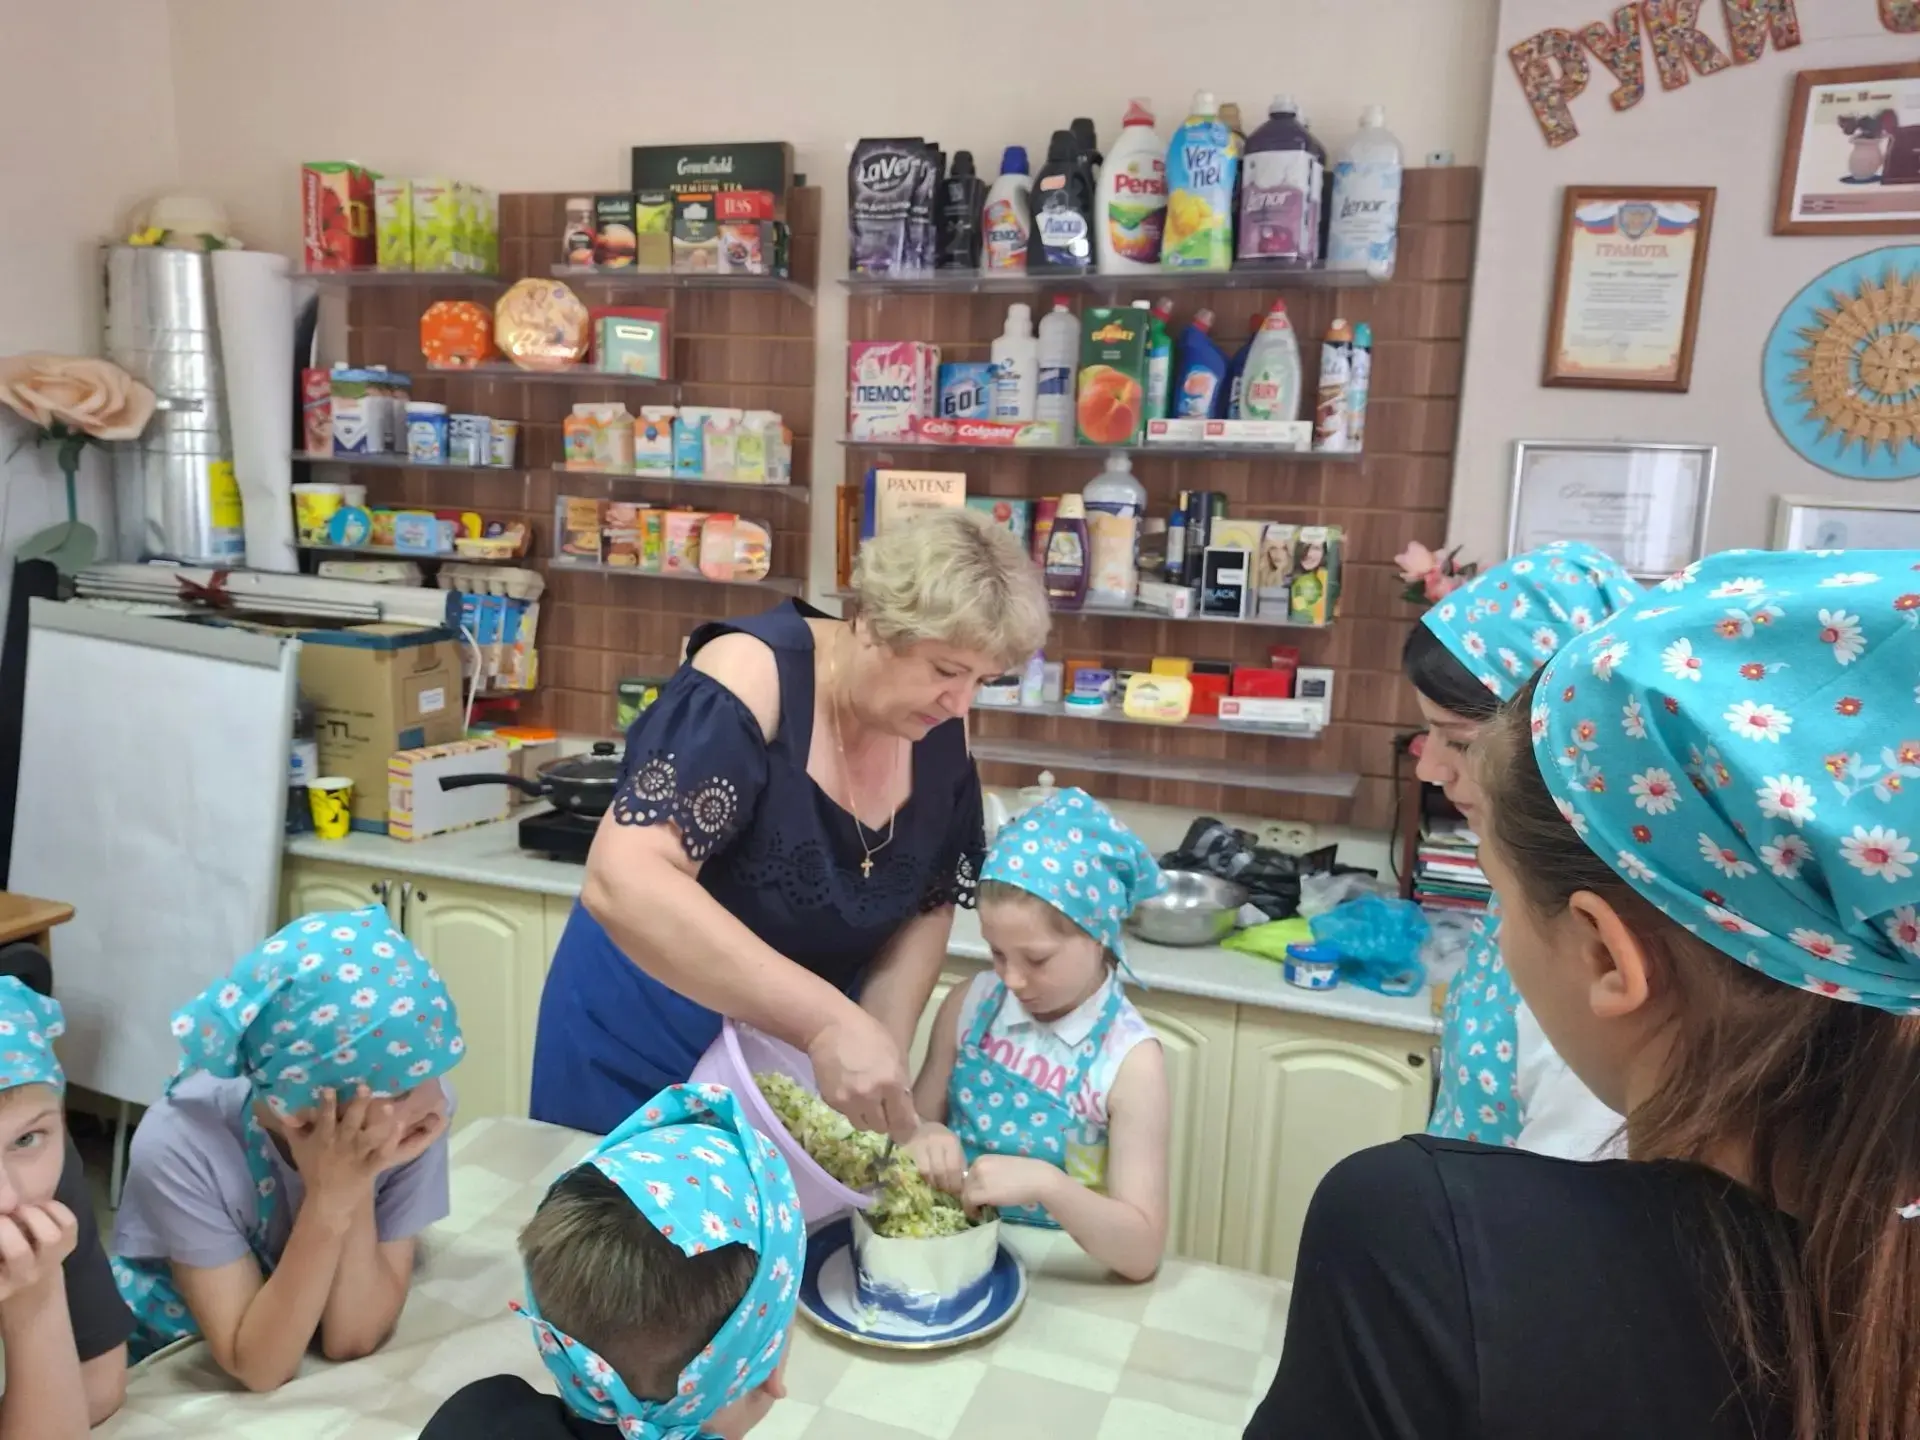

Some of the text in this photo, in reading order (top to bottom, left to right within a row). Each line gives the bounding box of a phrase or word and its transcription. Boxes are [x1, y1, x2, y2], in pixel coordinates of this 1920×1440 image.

[1509, 0, 1803, 148] РУКИ
[677, 156, 732, 175] Greenfield
[1185, 145, 1216, 170] Ver
[1596, 243, 1669, 258] ГРАМОТА
[857, 385, 911, 402] ПЕМОС
[958, 424, 1015, 440] Colgate
[887, 478, 955, 493] PANTENE
